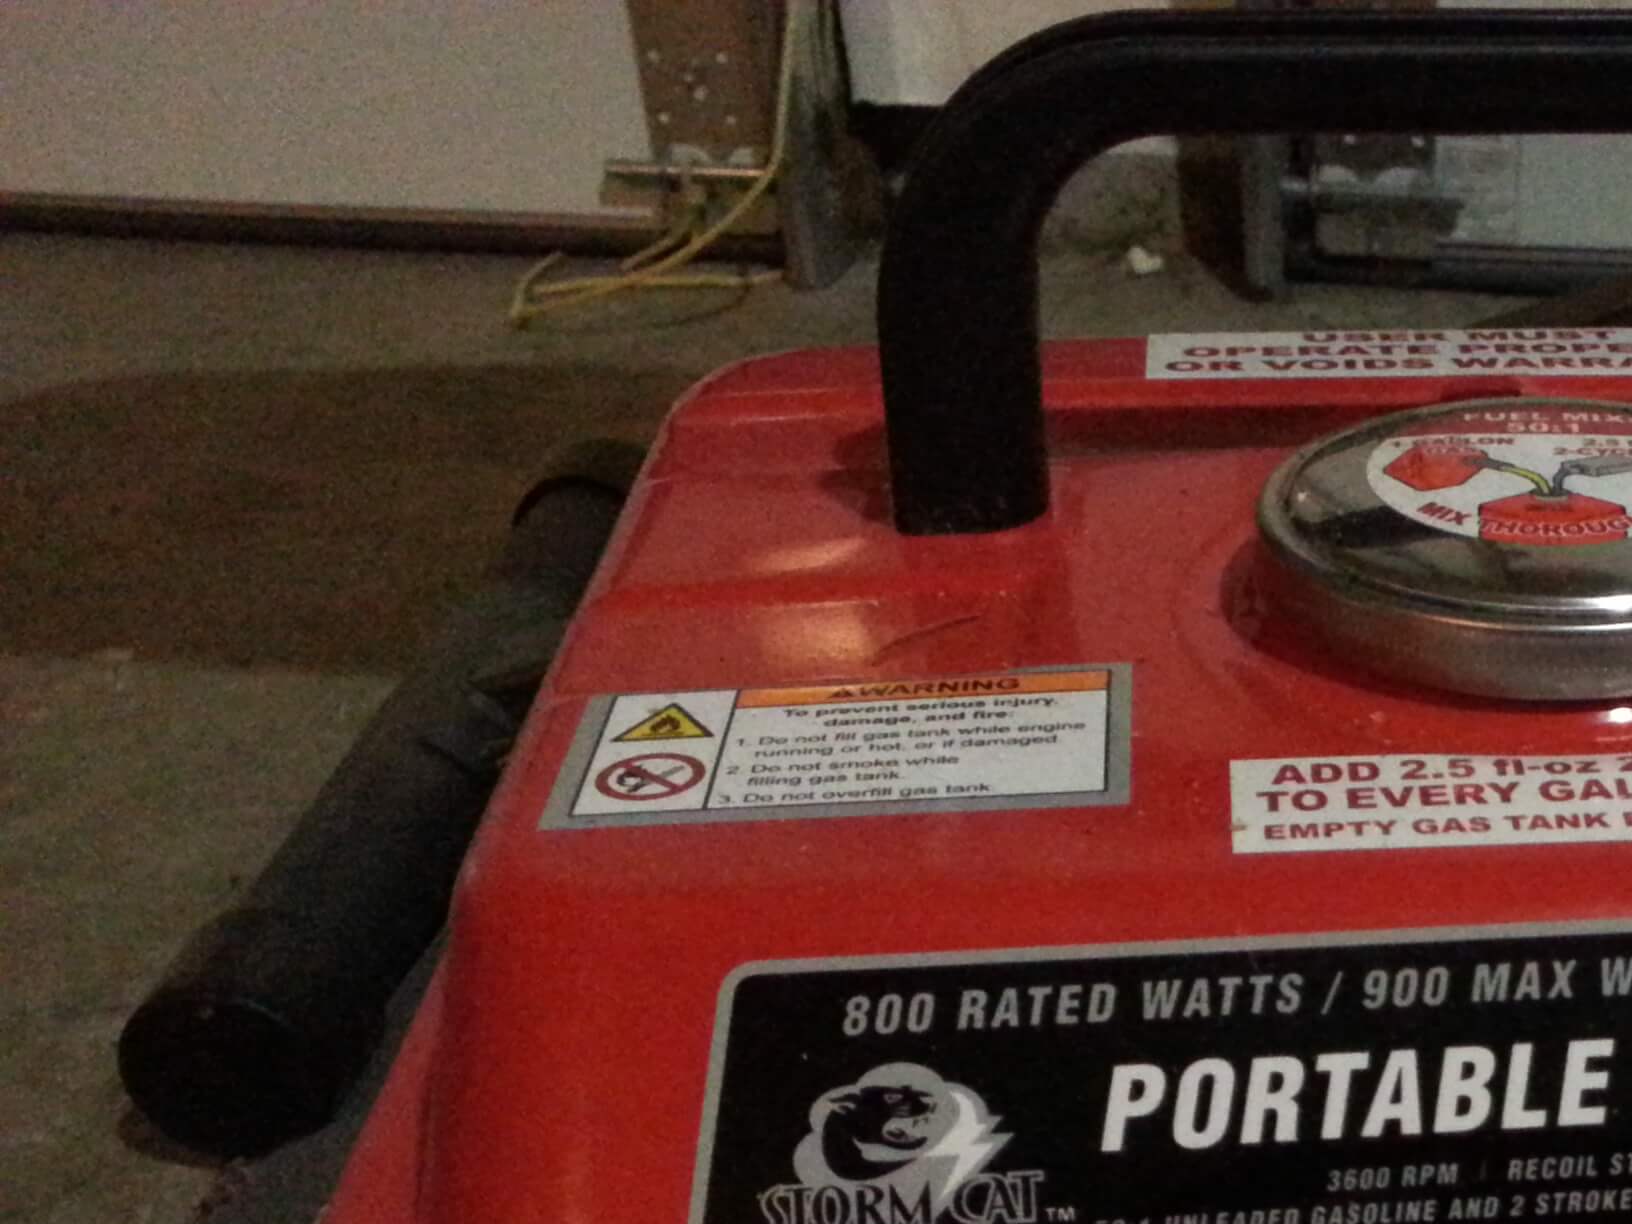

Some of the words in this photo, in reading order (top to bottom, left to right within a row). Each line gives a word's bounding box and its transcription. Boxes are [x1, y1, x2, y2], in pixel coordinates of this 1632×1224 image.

[1301, 332, 1449, 342] USER
[1467, 330, 1616, 341] MUST
[1183, 345, 1438, 357] OPERATE
[1165, 360, 1244, 371] OR
[1262, 358, 1434, 371] VOIDS
[1463, 411, 1550, 422] FUEL
[1506, 422, 1580, 433] 50:1
[1417, 501, 1472, 526] MIX
[861, 678, 1020, 697] WARNING
[784, 708, 809, 718] To
[815, 703, 900, 718] prevent
[906, 700, 987, 711] serious
[925, 711, 966, 722] and
[758, 736, 789, 745] Do
[795, 733, 828, 743] not
[834, 731, 857, 741] fill
[863, 730, 901, 741] gas
[908, 728, 951, 738] tank
[957, 725, 1011, 736] while
[1017, 721, 1087, 733] engine
[754, 746, 834, 759] running
[841, 745, 862, 753] or
[915, 741, 937, 750] or
[942, 739, 956, 749] if
[751, 763, 782, 774] Do
[788, 761, 822, 772] not
[829, 758, 899, 770] smoke
[905, 754, 960, 766] while
[1271, 761, 1380, 785] ADD
[1401, 758, 1476, 780] 2.5
[1493, 757, 1602, 777] fl-oz
[747, 775, 802, 788] filling
[809, 773, 848, 786] gas
[743, 793, 774, 803] Do
[781, 791, 815, 801] not
[822, 787, 892, 800] overfill
[899, 786, 938, 798] gas
[1256, 789, 1328, 813] TO
[1347, 782, 1520, 809] EVERY
[1263, 819, 1397, 841] EMPTY
[1412, 816, 1491, 835] GAS
[1503, 812, 1611, 831] TANK
[842, 992, 936, 1037] 800
[956, 984, 1117, 1032] RATED
[1142, 973, 1305, 1021] WATTS
[1362, 966, 1450, 1010] 900
[1471, 959, 1577, 1003] MAX
[1100, 1038, 1616, 1154] PORTABLE
[1326, 1166, 1391, 1193] 3600
[1401, 1162, 1460, 1188] RPM
[1507, 1154, 1599, 1182] RECOIL
[1447, 1194, 1501, 1219] AND
[1508, 1193, 1526, 1217] 2
